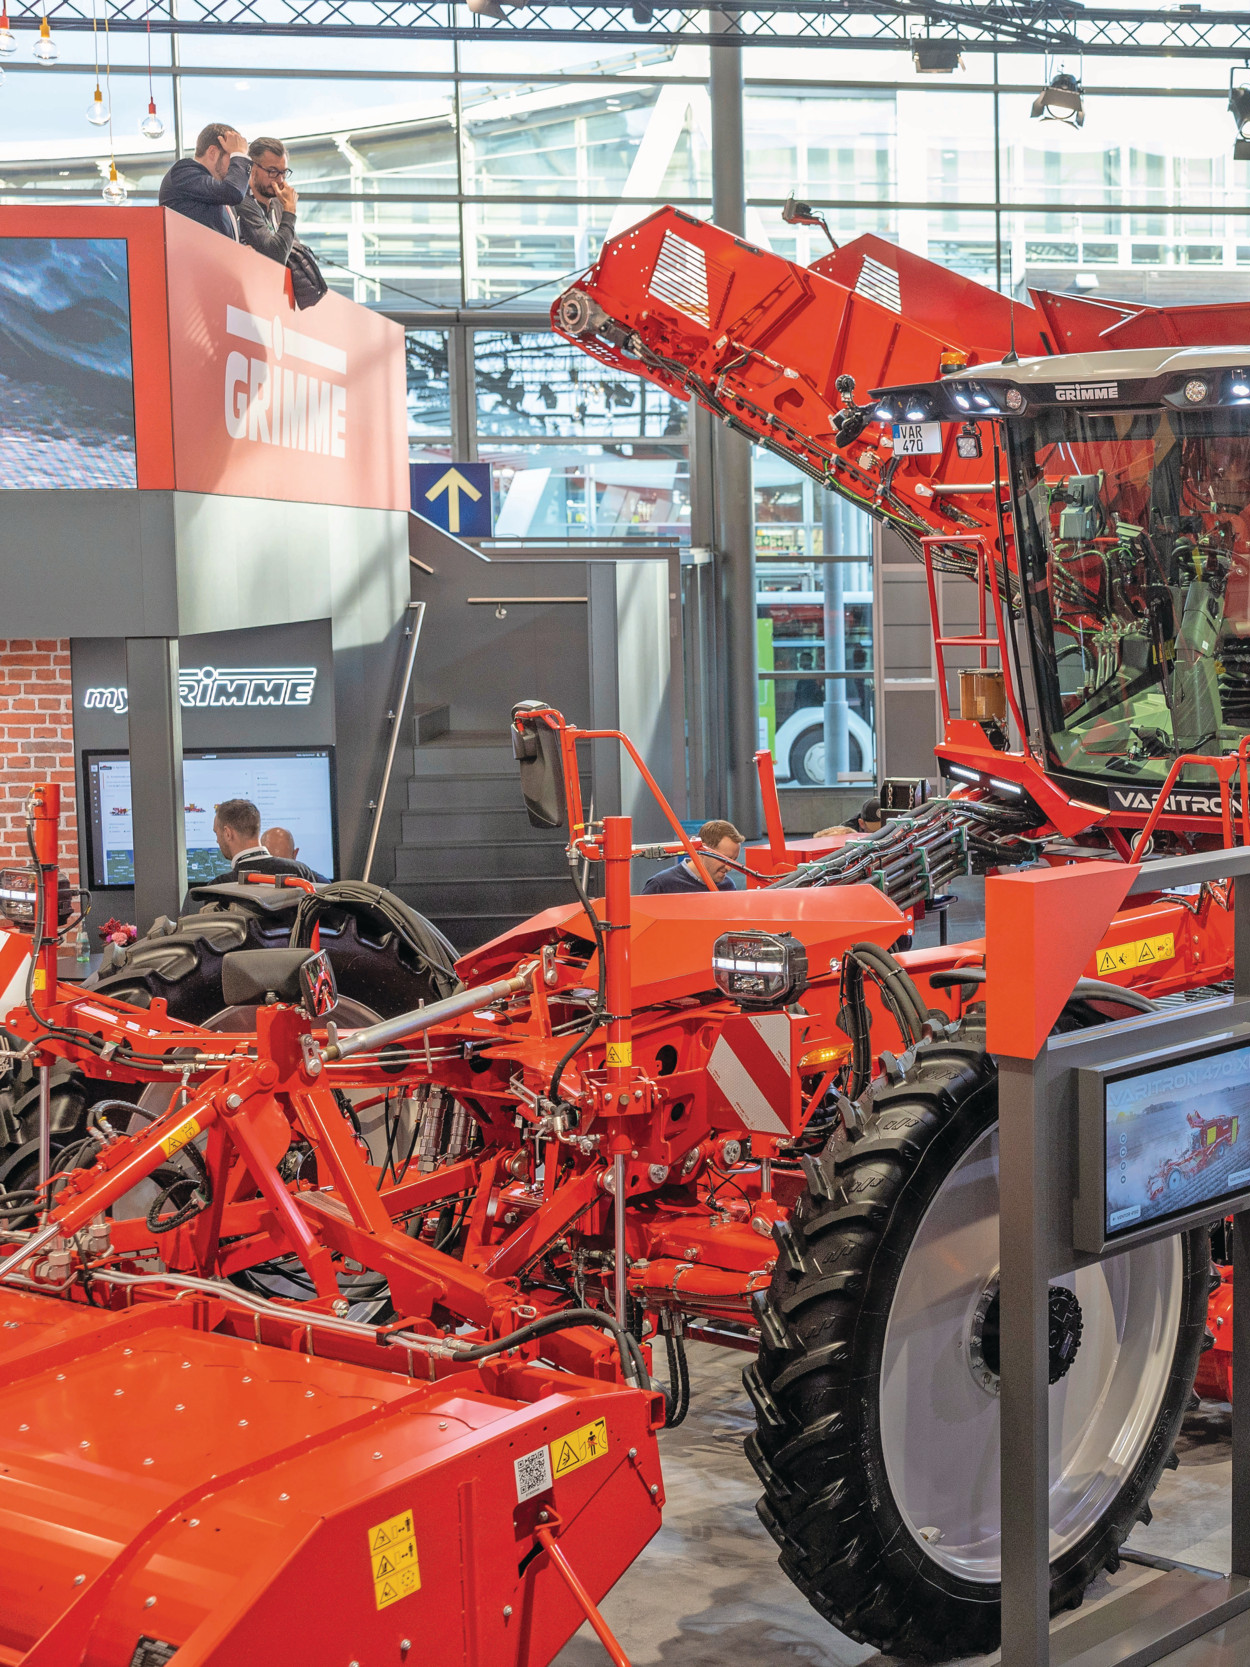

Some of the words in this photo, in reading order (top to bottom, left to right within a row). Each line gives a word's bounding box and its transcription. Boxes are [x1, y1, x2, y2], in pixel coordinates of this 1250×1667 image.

[225, 315, 346, 459] GRIMME
[1054, 383, 1119, 401] GRIMME
[901, 425, 923, 439] VAR
[902, 439, 924, 453] 470
[1110, 1071, 1198, 1106] VARITRON
[1201, 1062, 1233, 1080] 470
